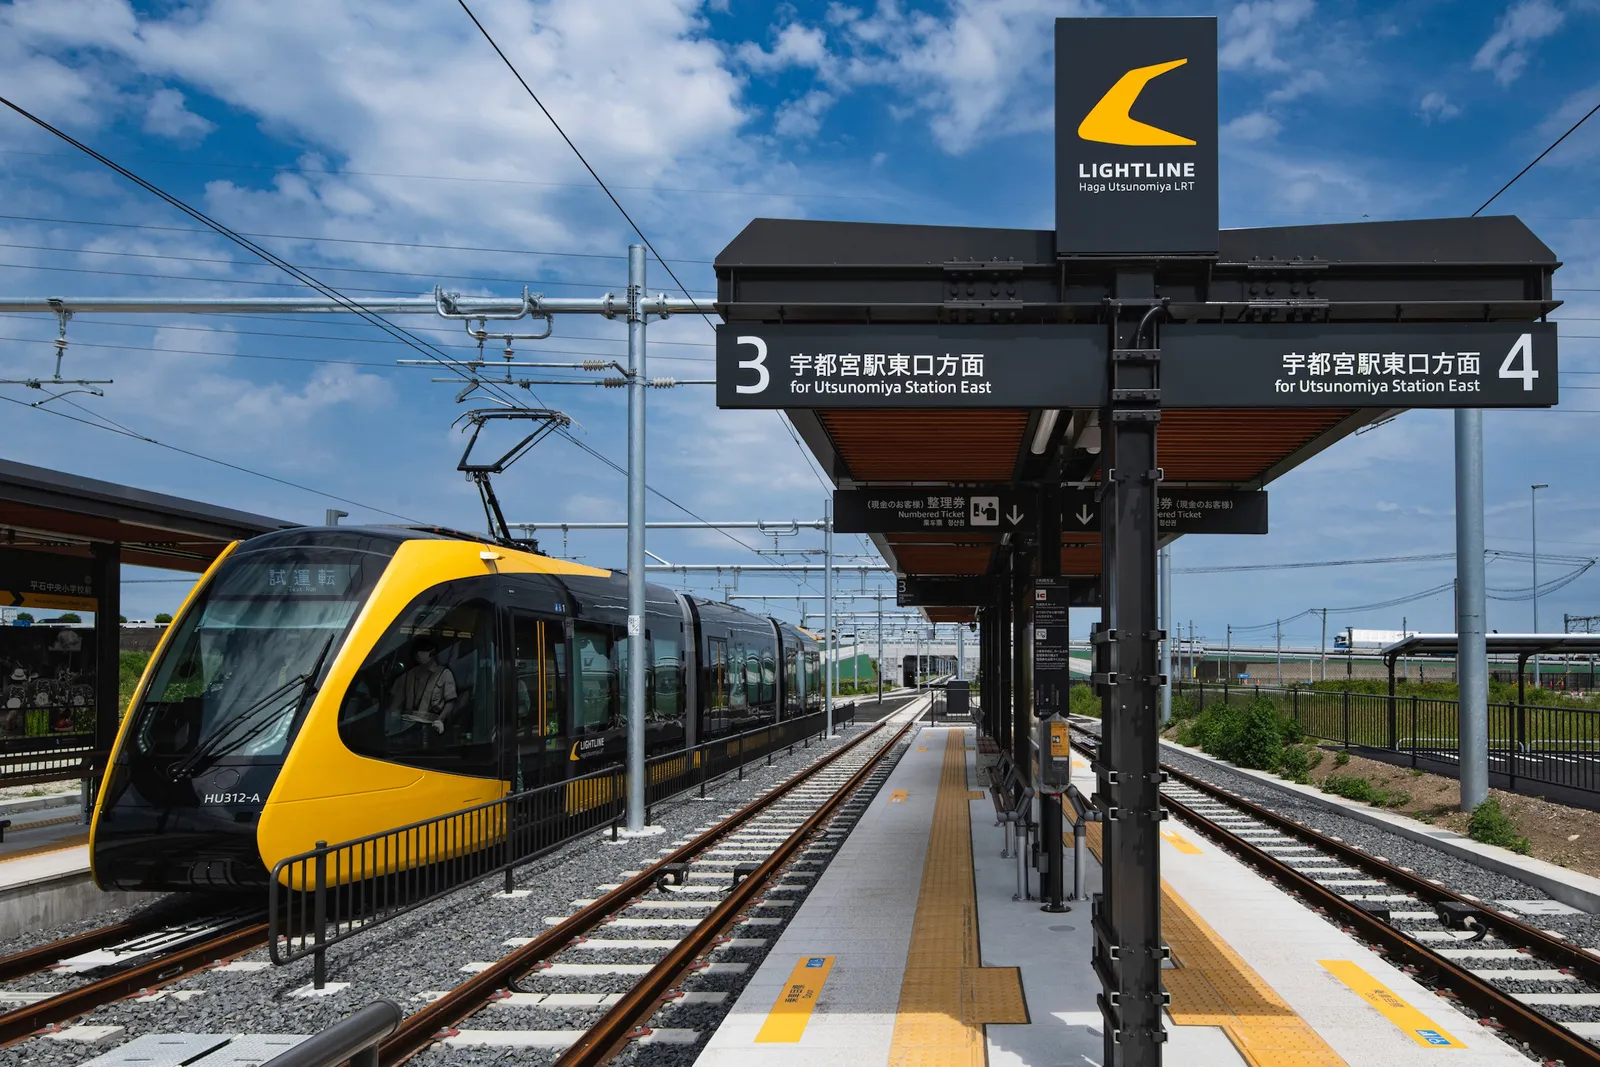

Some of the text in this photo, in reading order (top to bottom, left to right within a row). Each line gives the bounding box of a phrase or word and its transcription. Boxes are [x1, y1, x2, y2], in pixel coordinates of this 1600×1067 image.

[1079, 163, 1195, 178] LIGHTLINE
[1079, 181, 1195, 193] Haga Utsunomiya LRT
[735, 335, 770, 394] 3
[789, 353, 984, 378] 宇都宮駅東口方面
[1282, 351, 1481, 376] 宇都宮駅東口方面
[1498, 333, 1539, 391] 4
[790, 379, 992, 396] for Utsunomiya Station East
[1275, 378, 1481, 395] for Utsunomiya Station East
[927, 496, 965, 509] 整理券
[941, 510, 965, 518] Ticket
[269, 569, 336, 586] 試運転
[30, 580, 92, 595] 平石中央小学校前
[580, 737, 605, 750] LIGHTLINE
[204, 792, 261, 804] HU312-A
